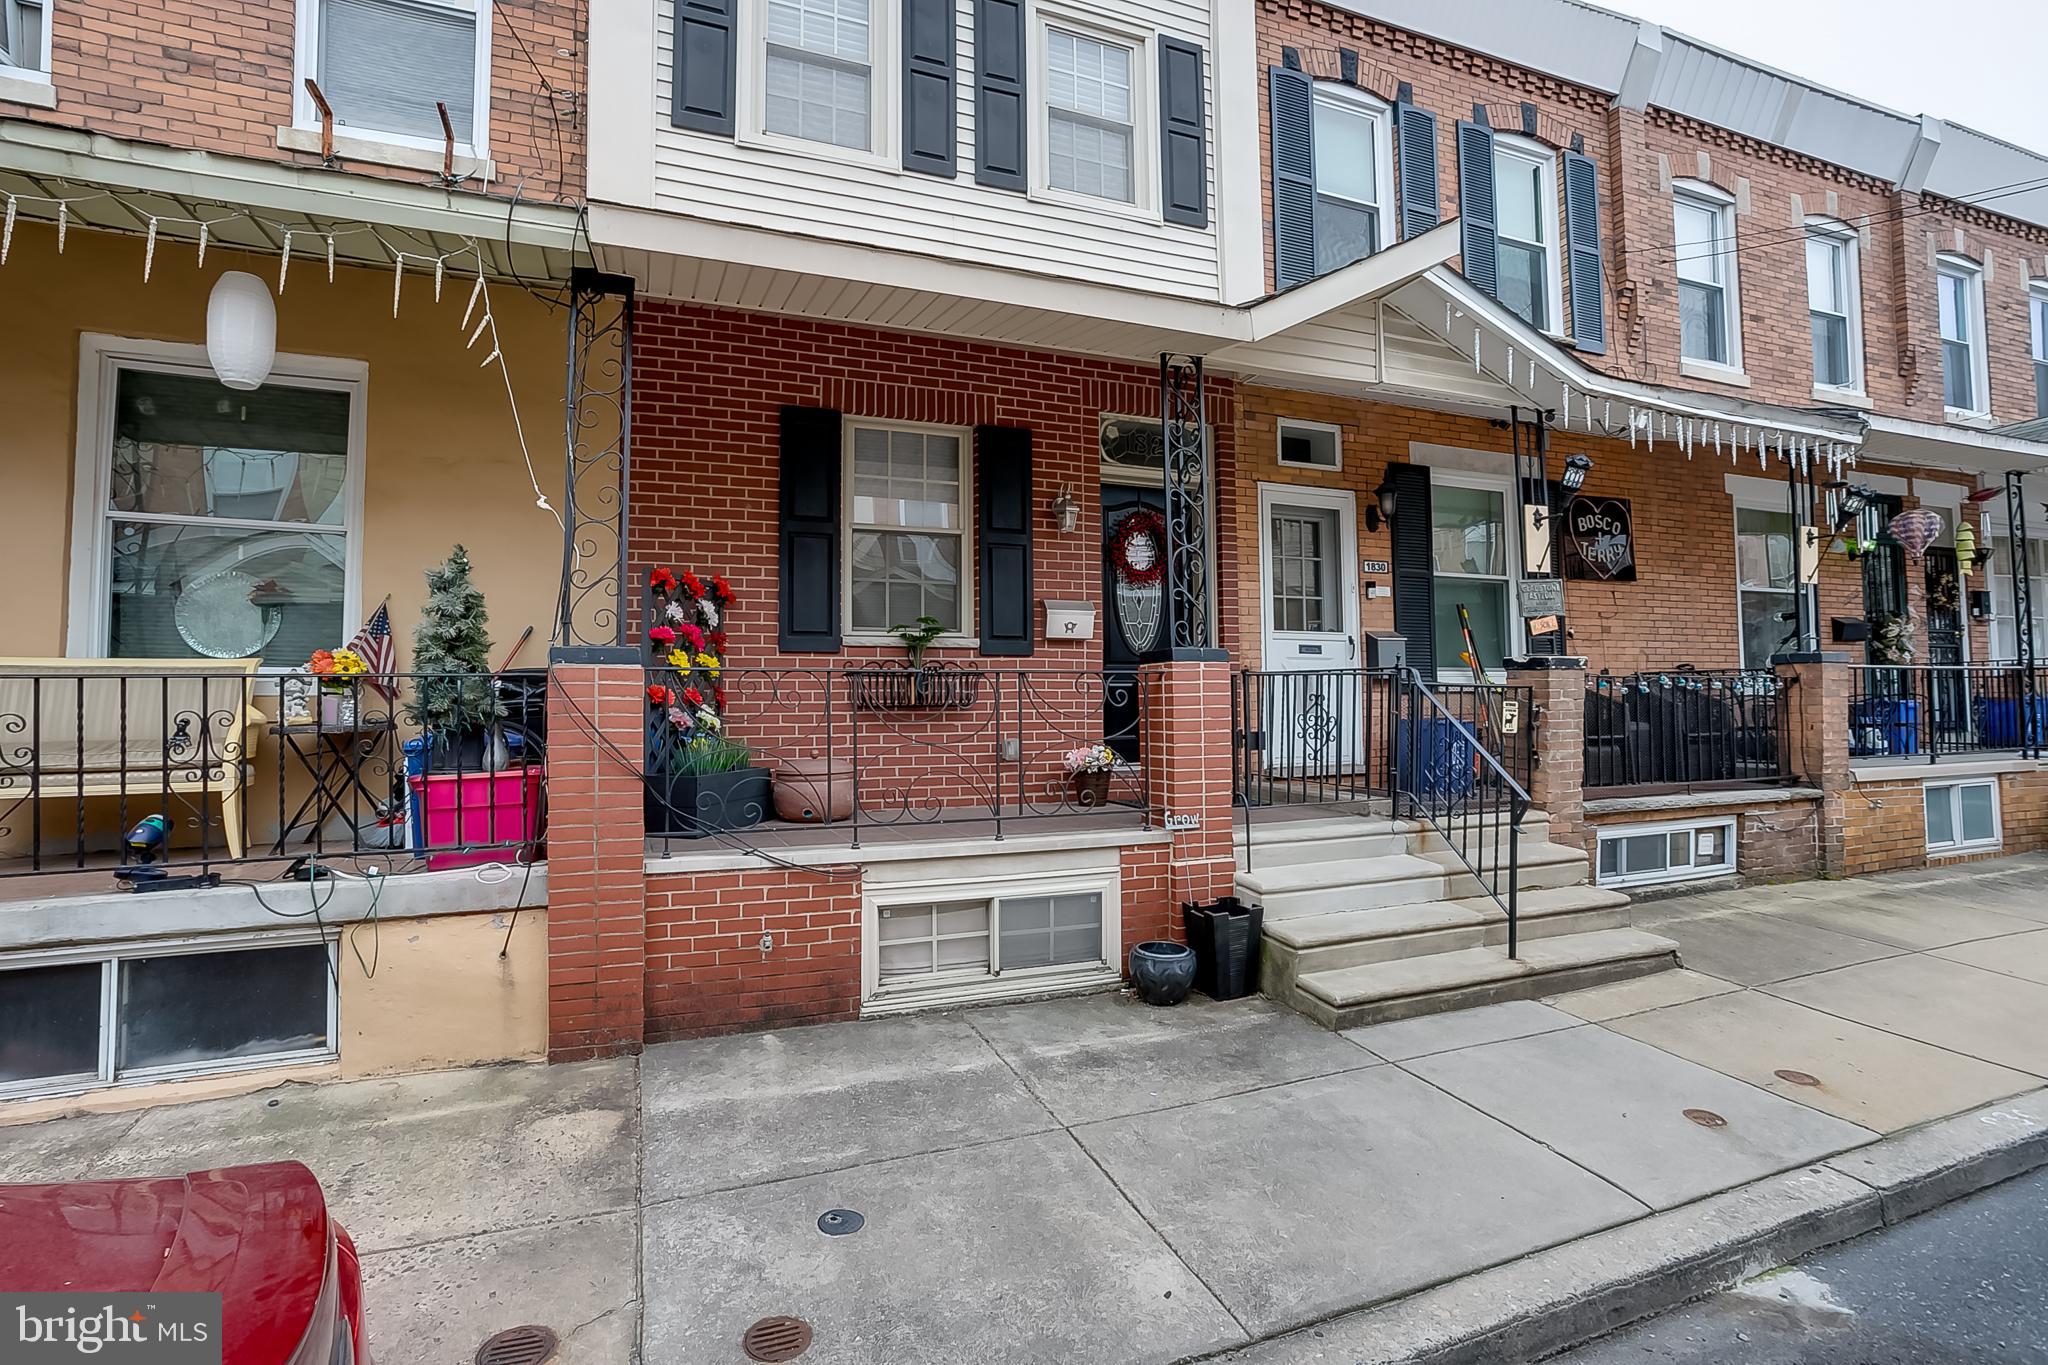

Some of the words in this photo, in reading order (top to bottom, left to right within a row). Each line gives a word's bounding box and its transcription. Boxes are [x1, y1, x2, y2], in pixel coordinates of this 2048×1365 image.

[1578, 515, 1621, 534] BOSCO
[1580, 541, 1624, 562] TERRY
[1366, 562, 1386, 571] 1830
[1164, 811, 1199, 827] Grow
